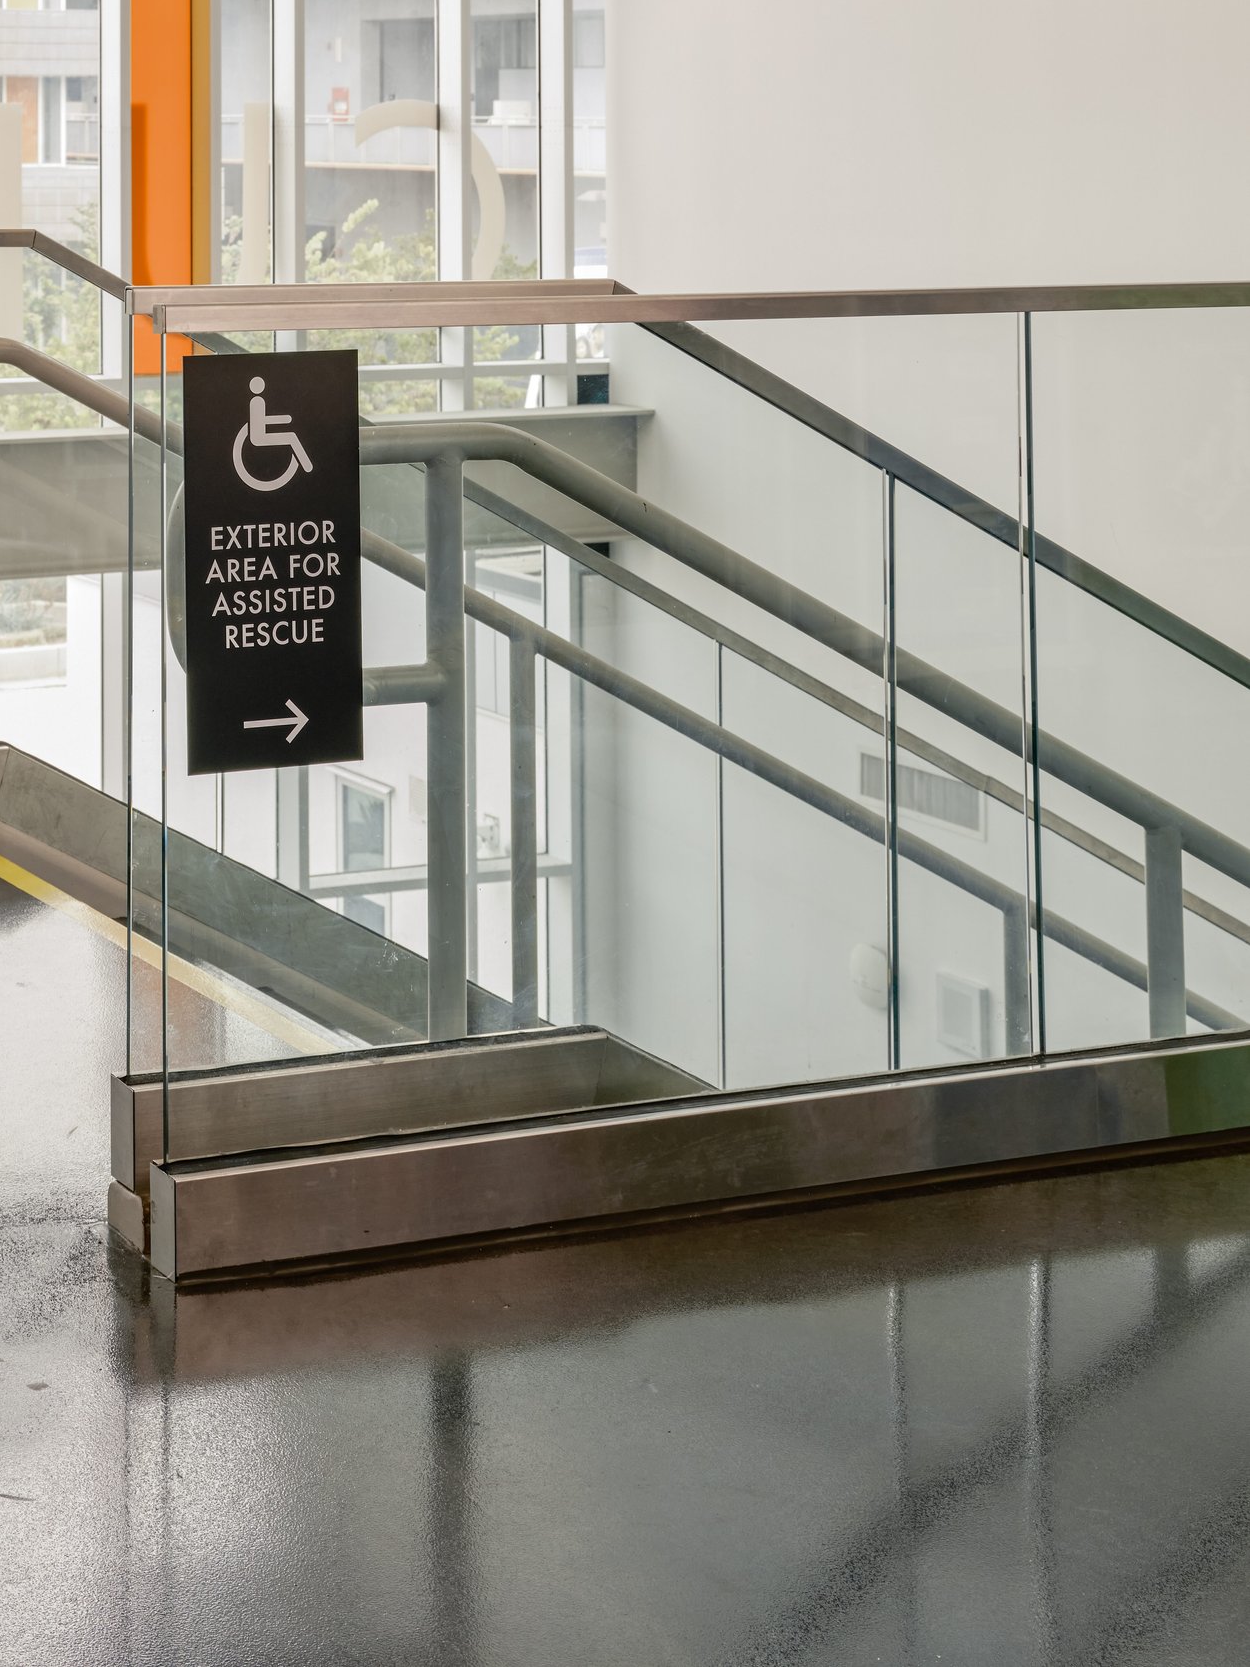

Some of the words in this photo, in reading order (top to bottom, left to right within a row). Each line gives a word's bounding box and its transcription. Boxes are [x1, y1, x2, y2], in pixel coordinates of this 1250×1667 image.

[210, 520, 336, 551] EXTERIOR
[205, 555, 278, 585] AREA
[289, 552, 341, 579] FOR
[211, 585, 336, 617] ASSISTED
[225, 618, 325, 649] RESCUE
